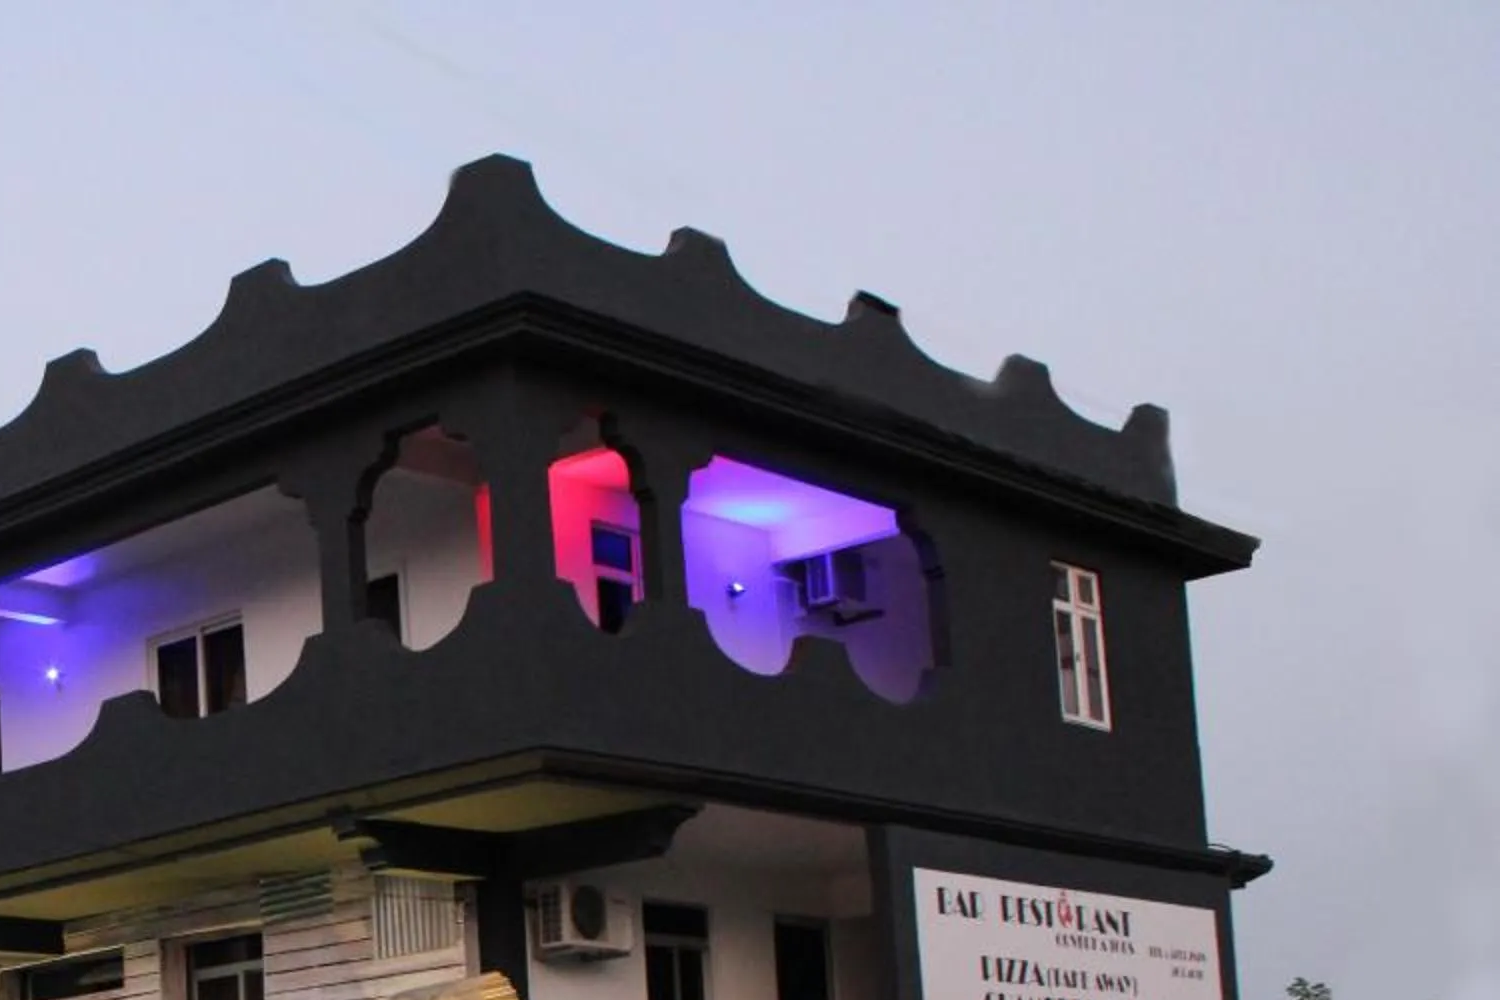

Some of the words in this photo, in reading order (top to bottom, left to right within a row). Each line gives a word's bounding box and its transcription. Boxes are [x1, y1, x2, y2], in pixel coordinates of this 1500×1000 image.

[936, 886, 981, 919] BAR
[980, 955, 1045, 987] PIZZA
[1094, 972, 1139, 996] AWAY)
